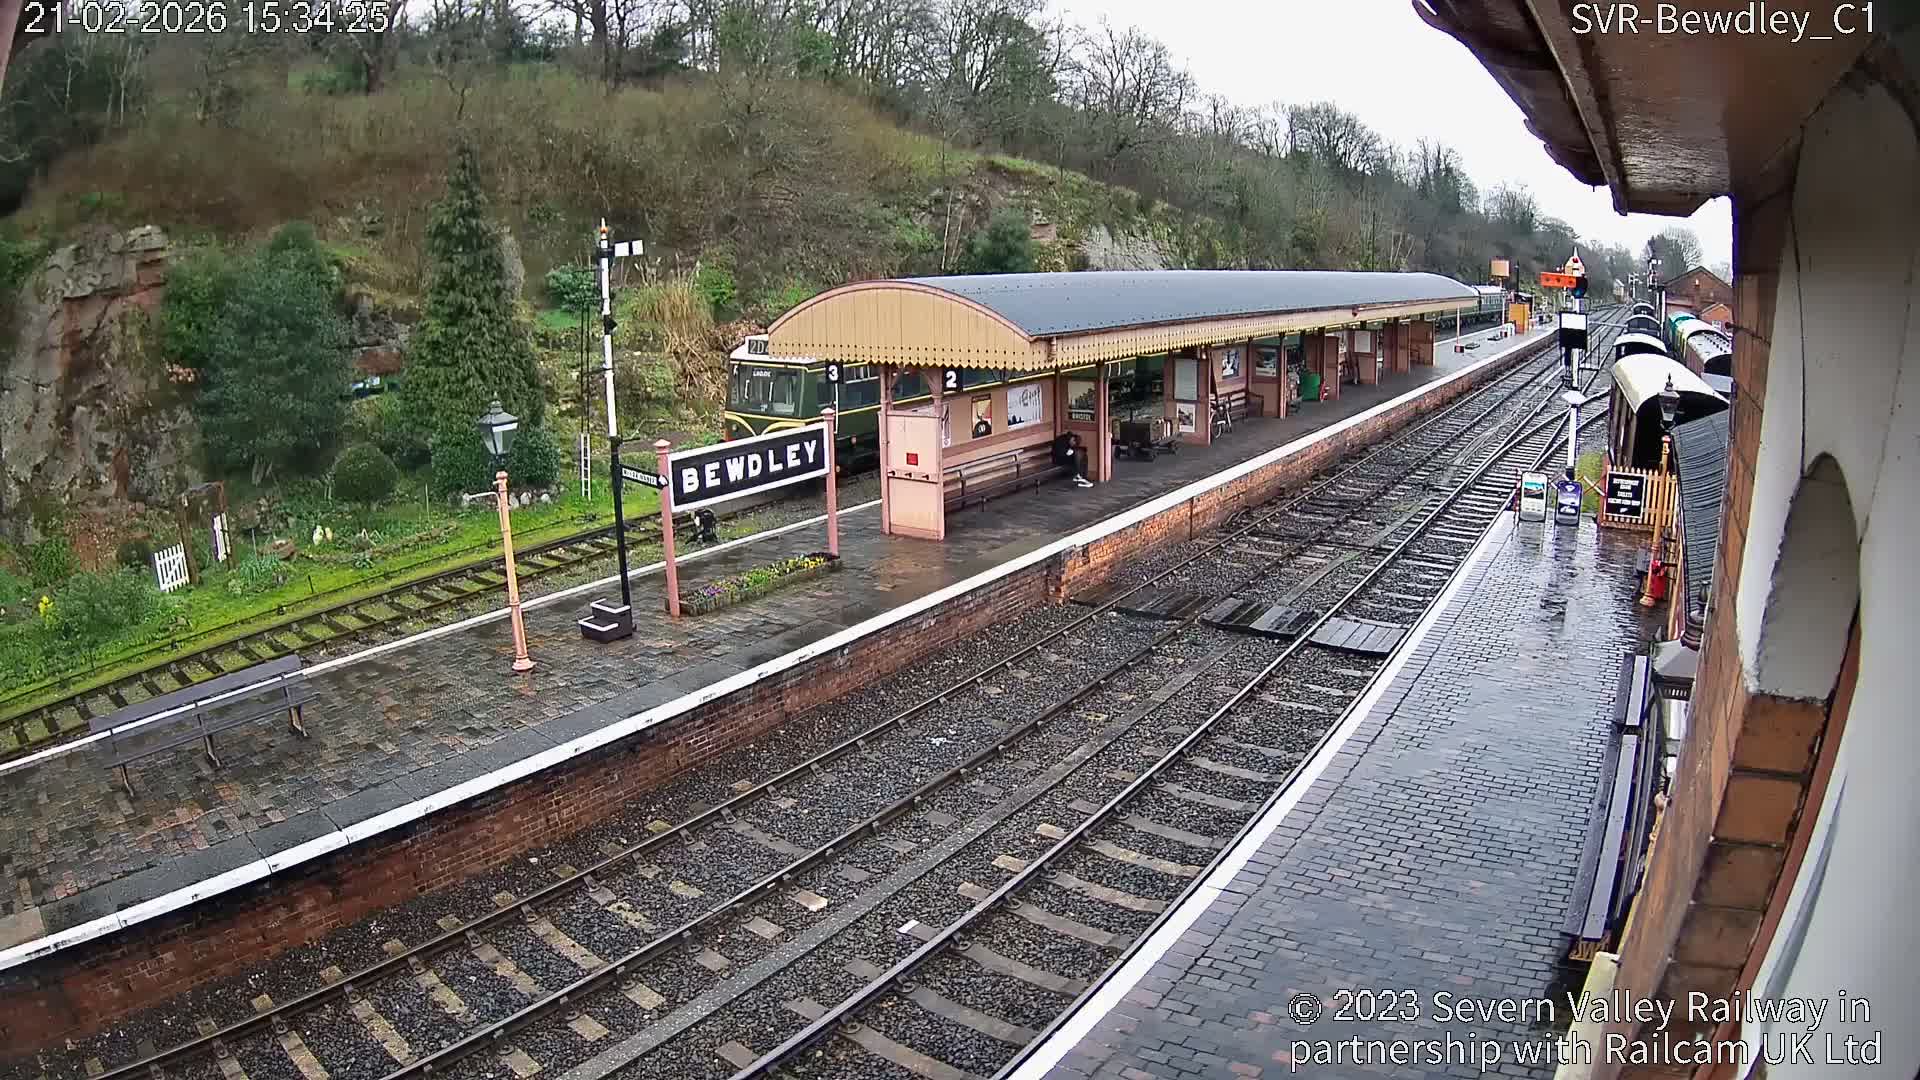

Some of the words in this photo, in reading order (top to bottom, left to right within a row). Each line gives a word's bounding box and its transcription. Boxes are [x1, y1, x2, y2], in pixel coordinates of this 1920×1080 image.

[828, 365, 838, 381] 3
[945, 371, 957, 388] 2
[681, 439, 817, 494] BEWDLEY
